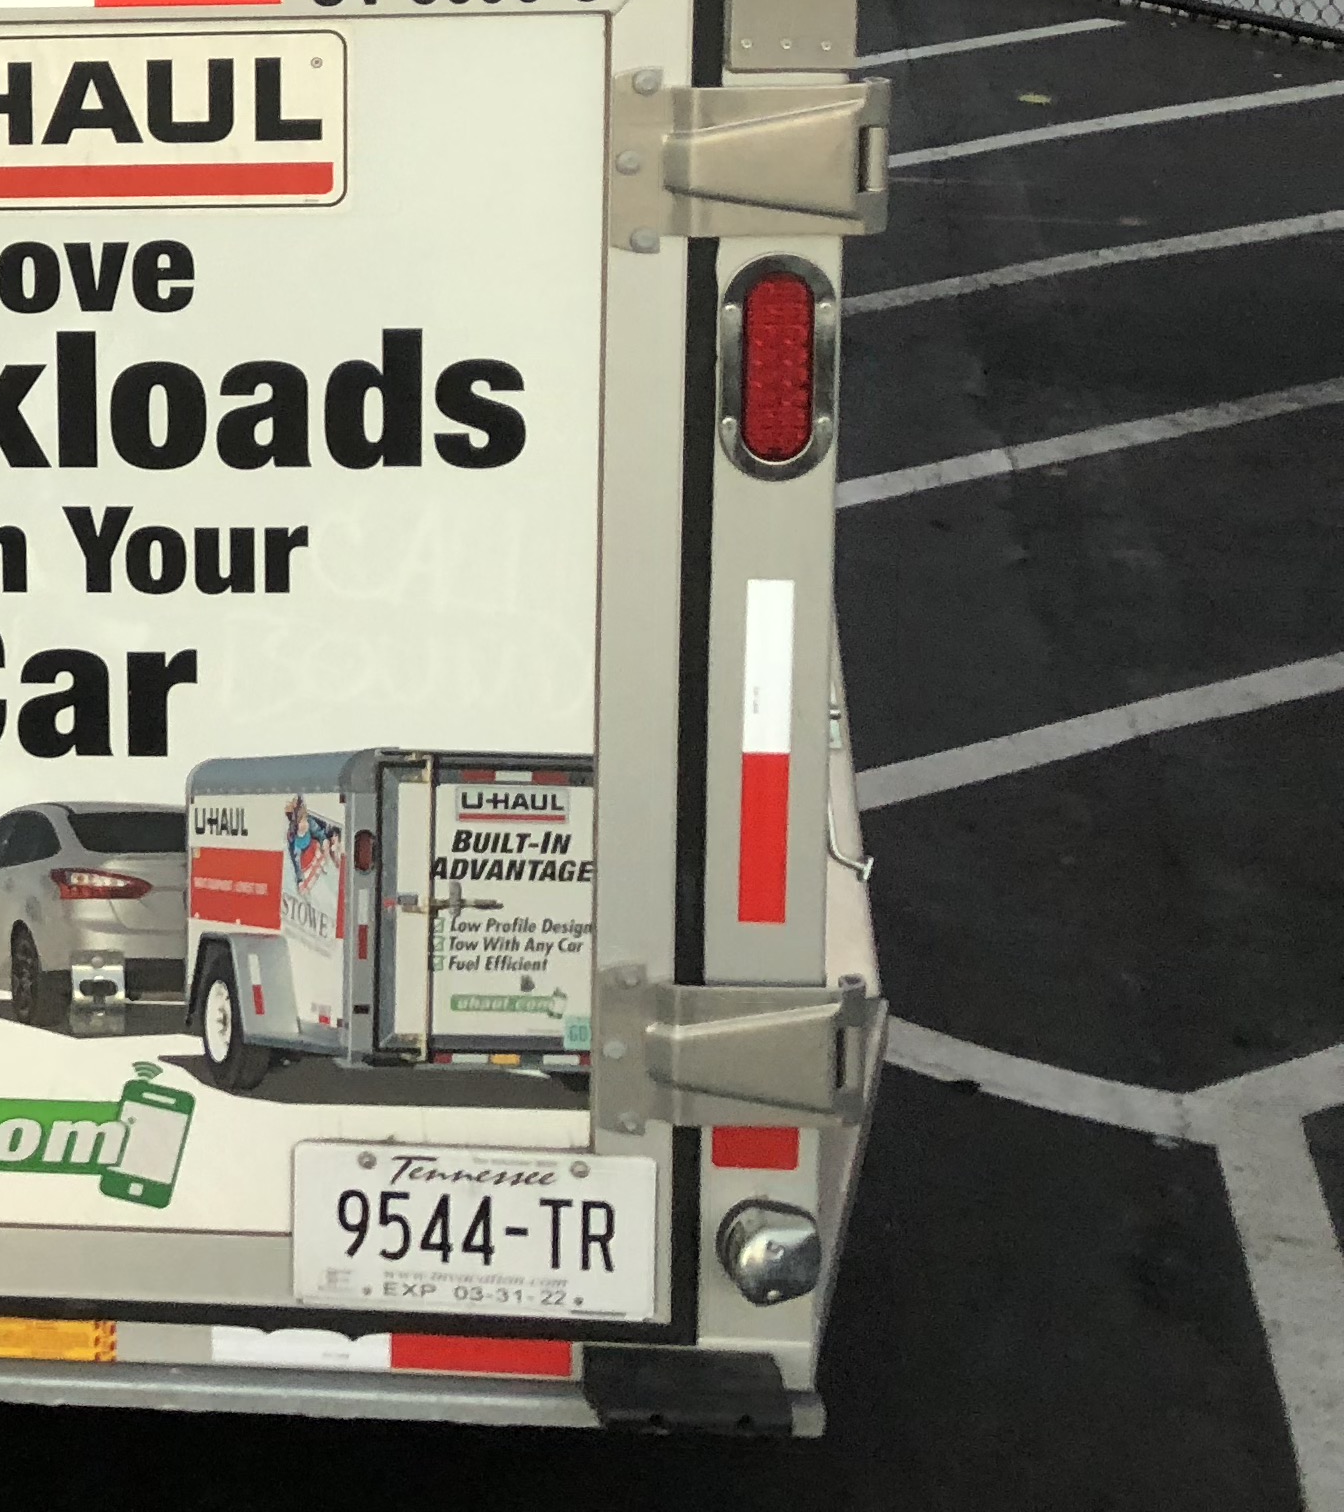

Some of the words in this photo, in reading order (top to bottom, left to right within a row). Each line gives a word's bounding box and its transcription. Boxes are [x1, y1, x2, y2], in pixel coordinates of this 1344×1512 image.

[62, 506, 309, 594] Your
[461, 791, 565, 811] U-HAUL
[194, 807, 248, 837] U-HAUL
[451, 829, 572, 855] BUILT-IN
[433, 856, 593, 882] ADVANTAGE
[450, 917, 481, 933] Low
[485, 917, 537, 934] Profile
[541, 918, 593, 938] Design
[449, 936, 479, 952] Tow
[483, 936, 520, 952] With
[524, 937, 554, 956] Any
[558, 938, 584, 953] Car
[448, 955, 481, 971] Fuel
[485, 955, 548, 972] Efficient
[390, 1155, 557, 1187] Tennessee
[337, 1189, 616, 1273] 9544-TR
[383, 1282, 437, 1297] EXP
[453, 1285, 568, 1306] 03-31-22
